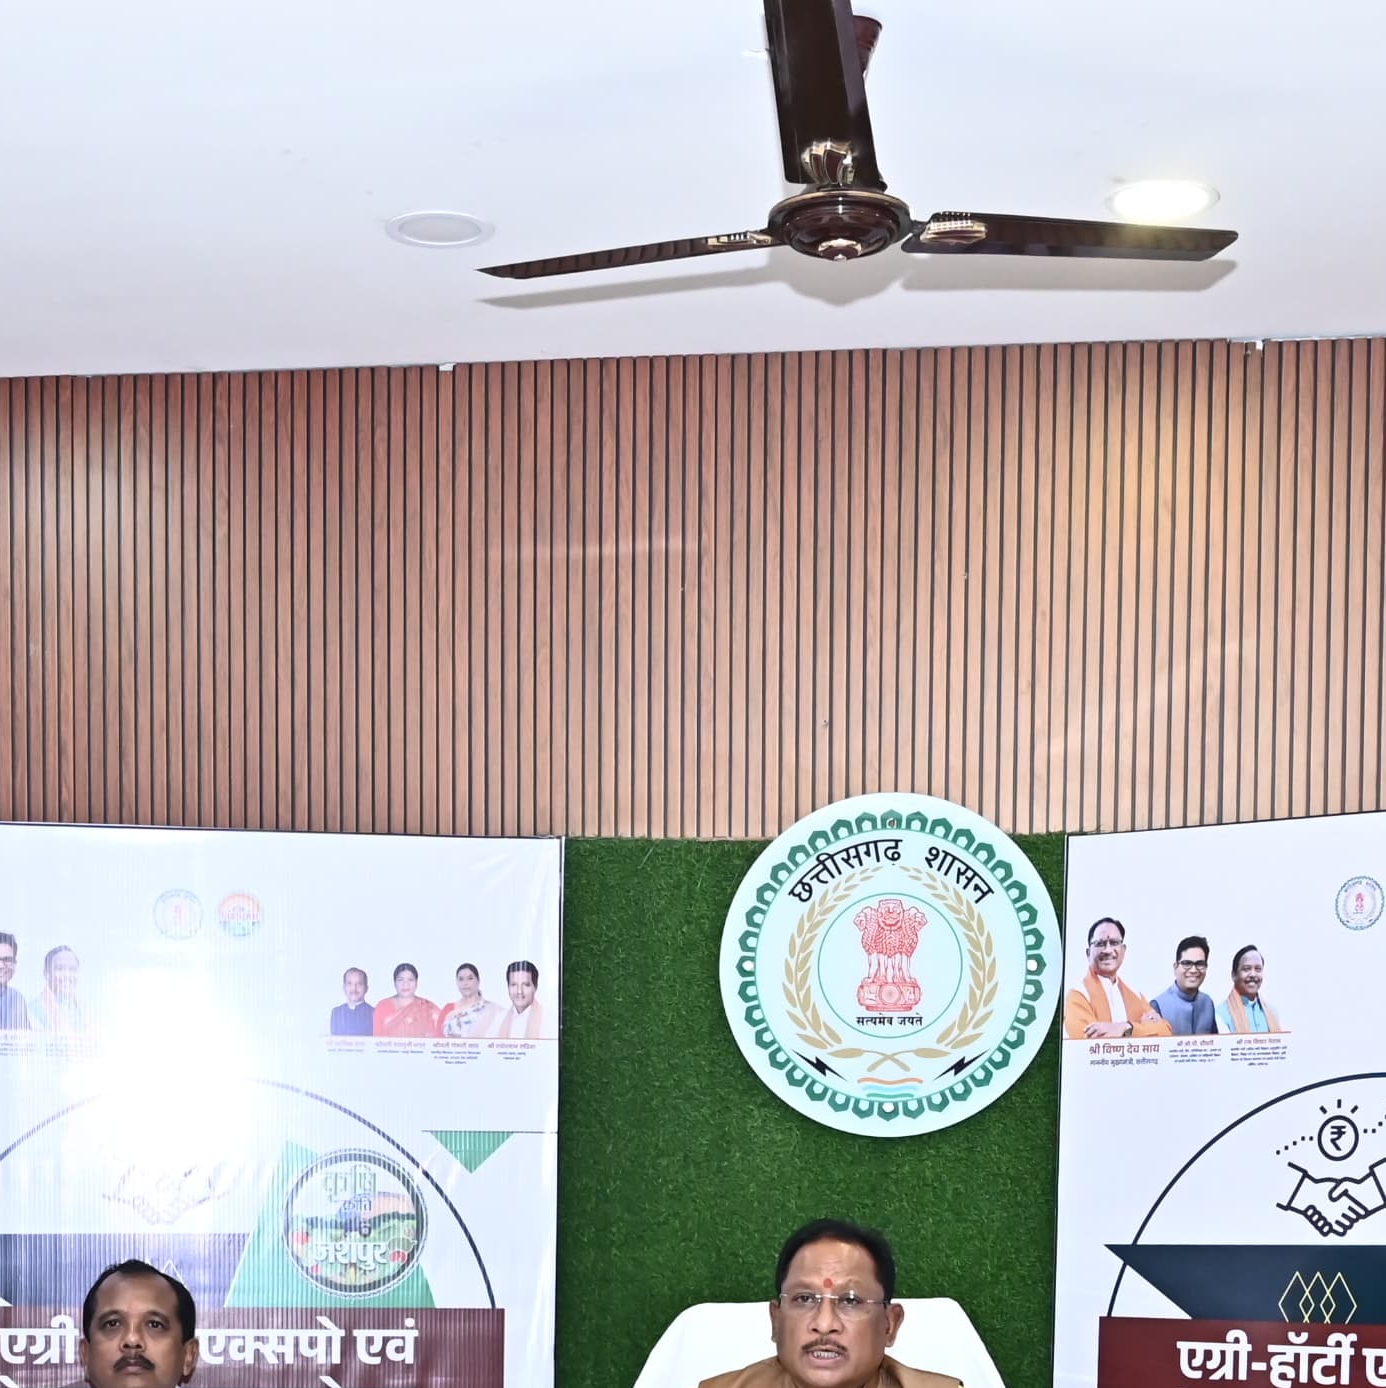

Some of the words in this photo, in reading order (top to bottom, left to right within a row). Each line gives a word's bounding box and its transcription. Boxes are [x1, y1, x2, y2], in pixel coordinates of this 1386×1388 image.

[787, 838, 903, 903] छत्तीसगढ़
[925, 844, 995, 904] शासन
[855, 1012, 894, 1026] सत्यमेव
[897, 1012, 923, 1026] जयते
[1089, 1042, 1100, 1055] श्री
[1102, 1042, 1125, 1057] विष्णु
[1126, 1042, 1140, 1054] देव
[1142, 1043, 1160, 1054] साय
[194, 1315, 346, 1365] एक्सपो
[352, 1317, 419, 1365] एवं
[1176, 1329, 1358, 1388] एग्री-हॉर्टी
